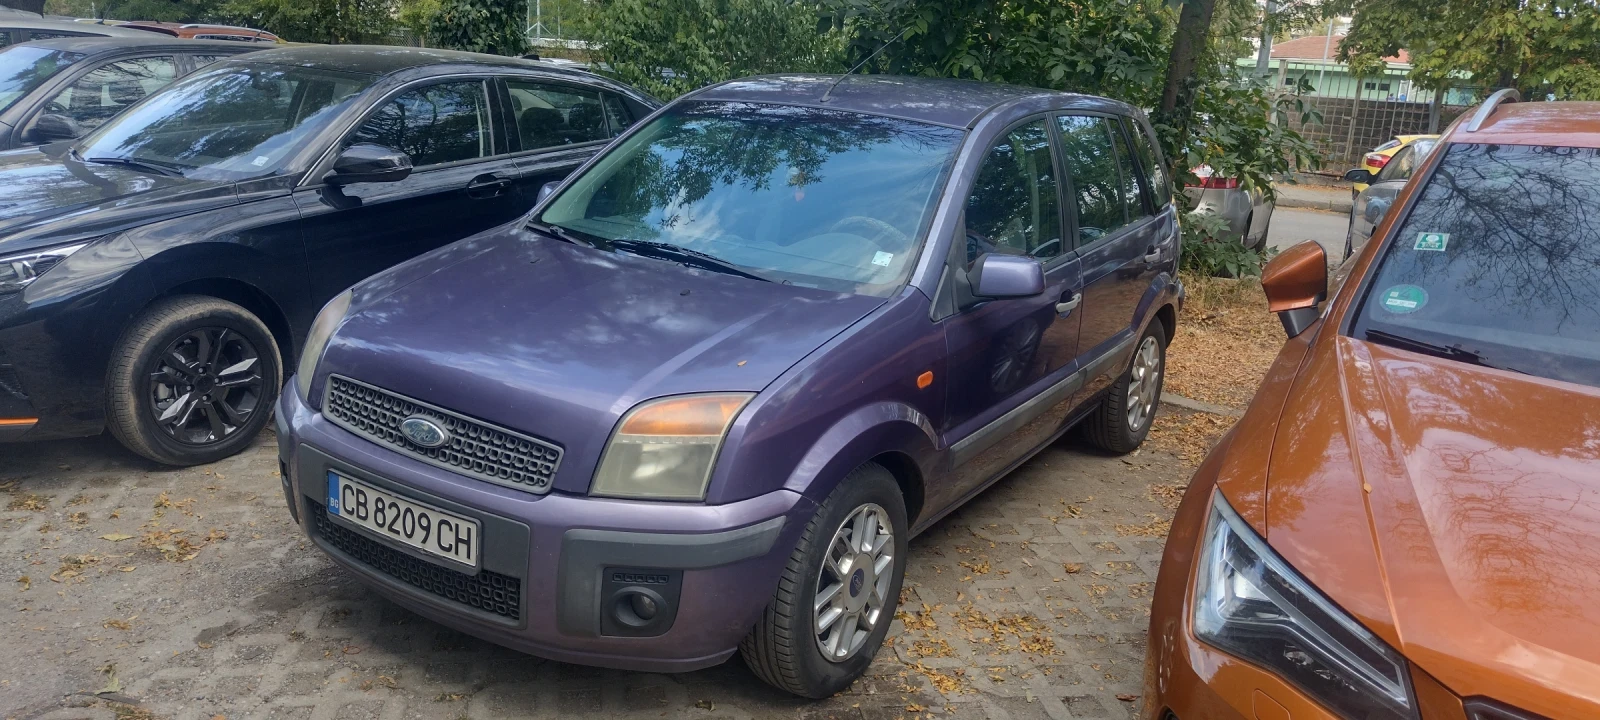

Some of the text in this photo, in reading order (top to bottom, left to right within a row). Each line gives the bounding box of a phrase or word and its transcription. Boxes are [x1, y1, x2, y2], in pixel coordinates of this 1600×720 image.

[330, 497, 339, 509] BG
[342, 484, 471, 560] CB 8209 CH
